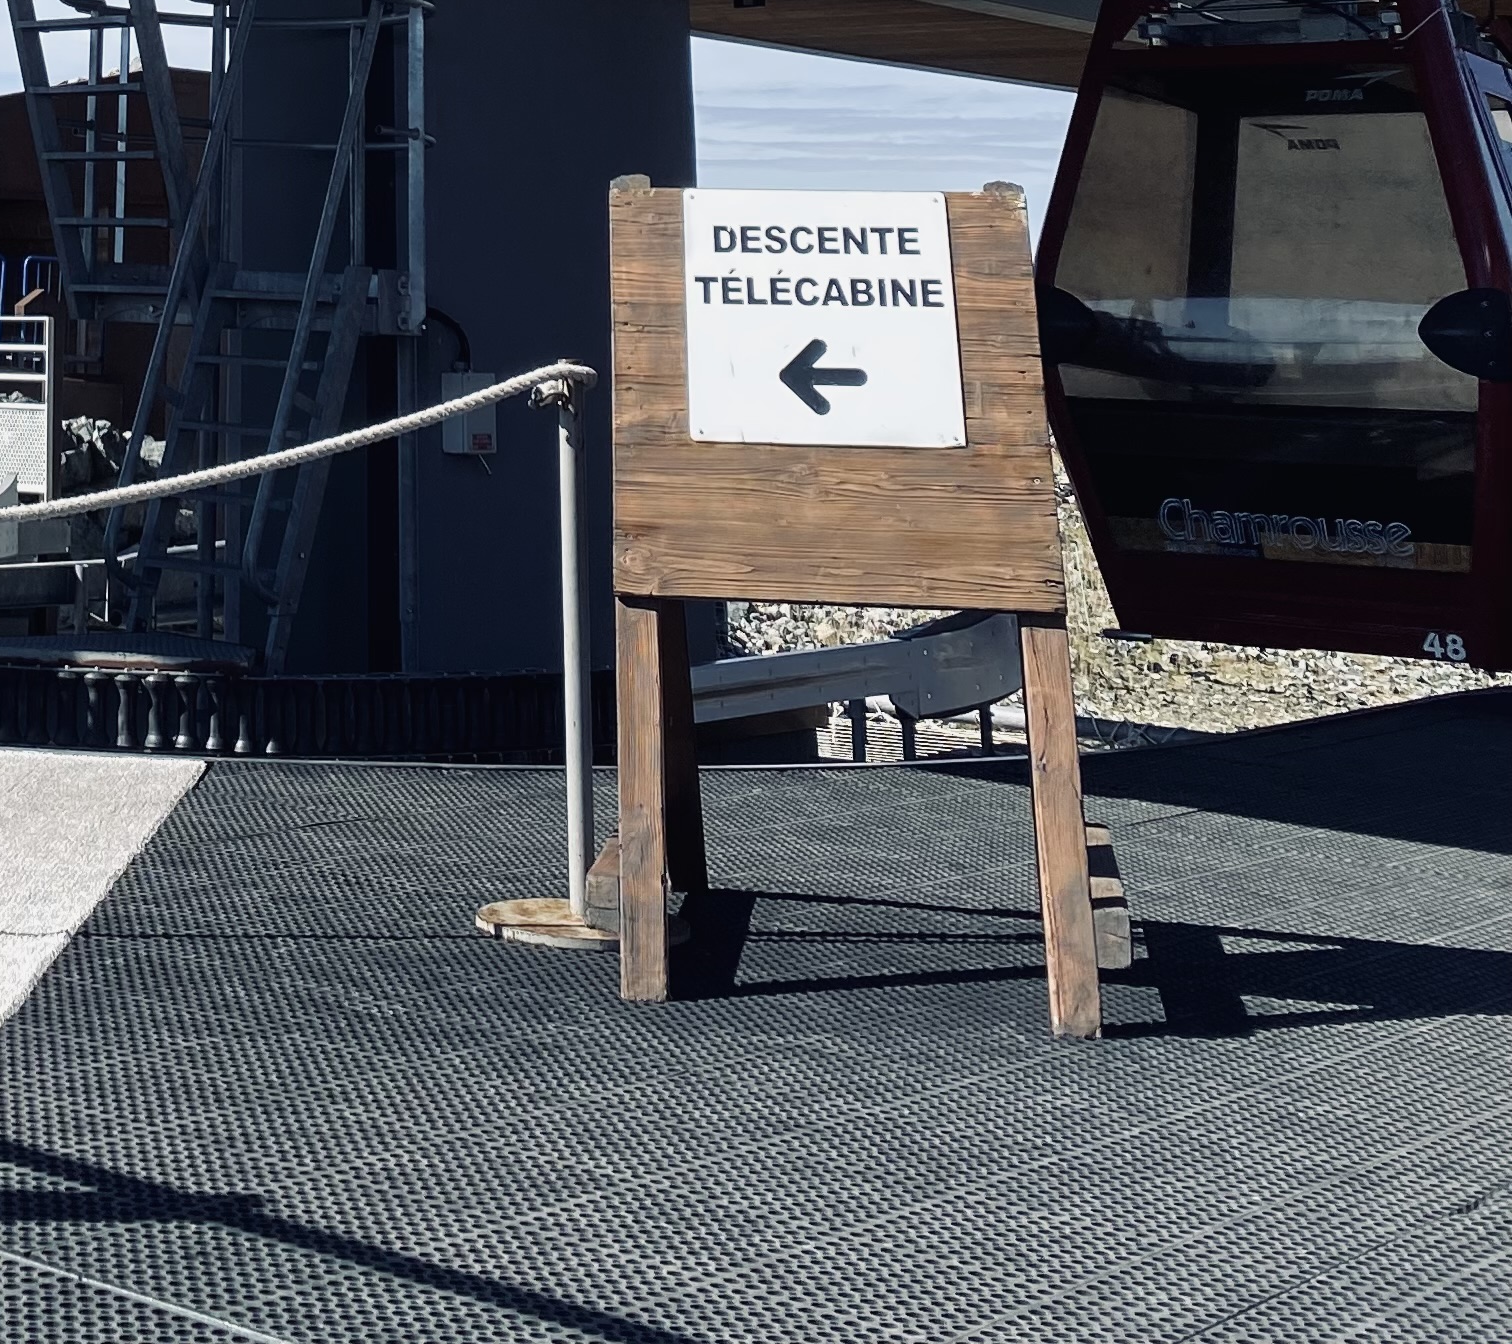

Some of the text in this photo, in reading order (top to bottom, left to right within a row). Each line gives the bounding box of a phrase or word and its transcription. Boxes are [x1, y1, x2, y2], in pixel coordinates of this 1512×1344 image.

[1305, 88, 1364, 102] POMA
[713, 225, 922, 256] DESCENTE
[694, 269, 945, 308] TÉLÉCABINE
[1159, 498, 1415, 557] Chamrousse
[1423, 632, 1467, 661] 48
